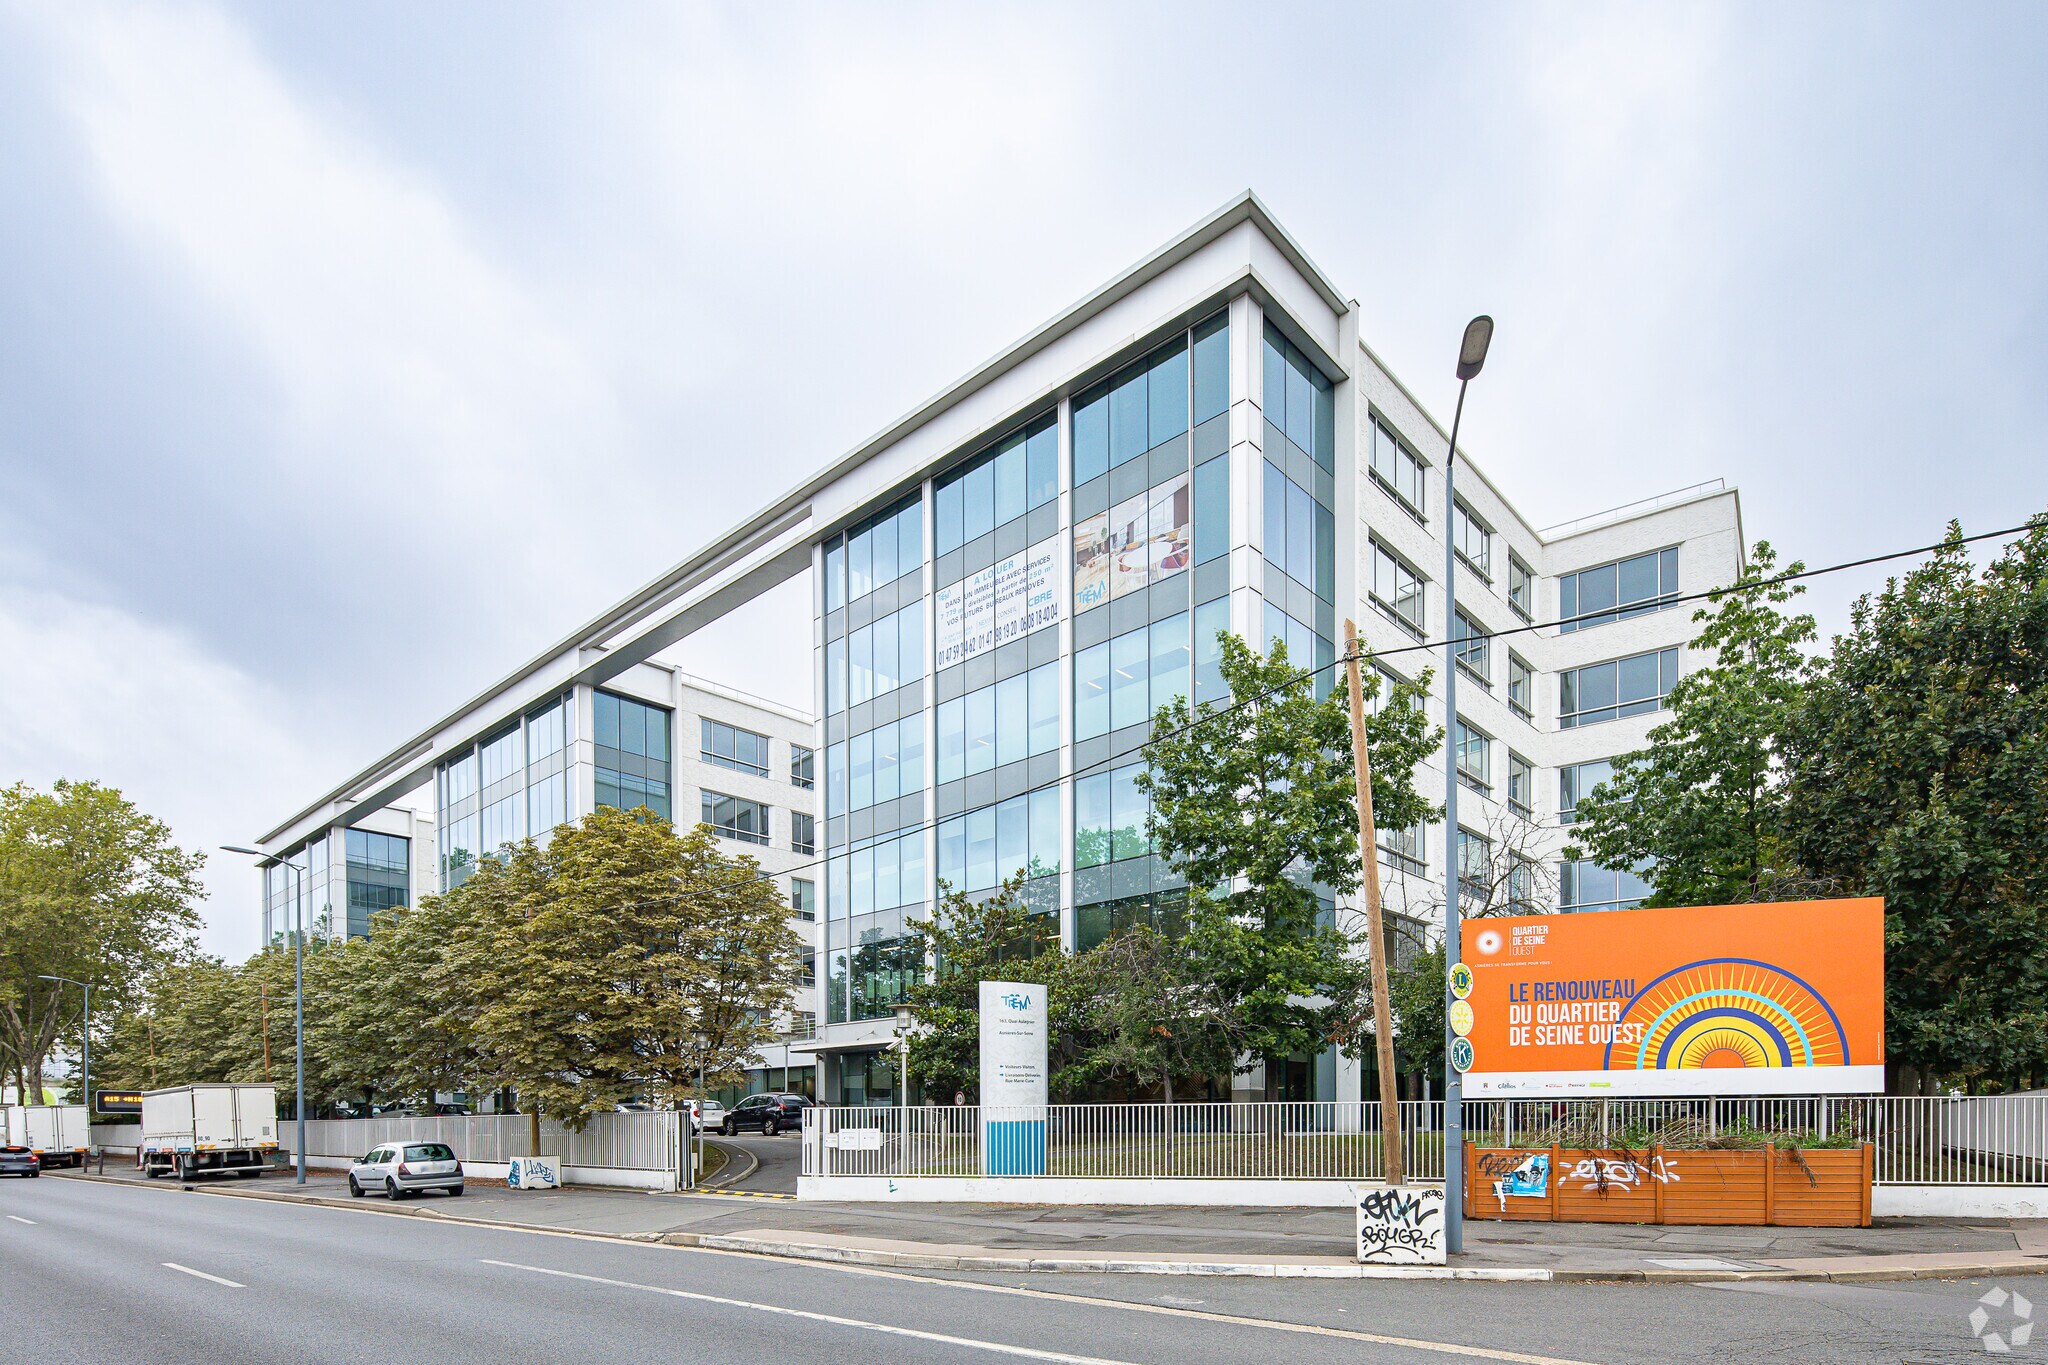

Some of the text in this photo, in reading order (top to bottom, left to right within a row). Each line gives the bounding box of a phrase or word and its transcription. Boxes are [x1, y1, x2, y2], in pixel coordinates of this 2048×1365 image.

[945, 597, 961, 609] DANS
[974, 575, 1005, 596] IMMEUBLE
[1006, 568, 1021, 581] AVEC
[1022, 554, 1051, 574] SERVICES
[974, 560, 1014, 585] A LOUER
[1028, 589, 1052, 607] CBRE
[946, 616, 959, 626] VOS
[1512, 925, 1549, 936] QUARTIER
[1512, 935, 1545, 946] DE SEINE
[1512, 946, 1535, 956] OUEST
[1509, 979, 1635, 1002] LE RENOUVEAU
[1510, 1001, 1620, 1025] DU QUARTIER
[1510, 1023, 1644, 1046] DE SEINE OUEST
